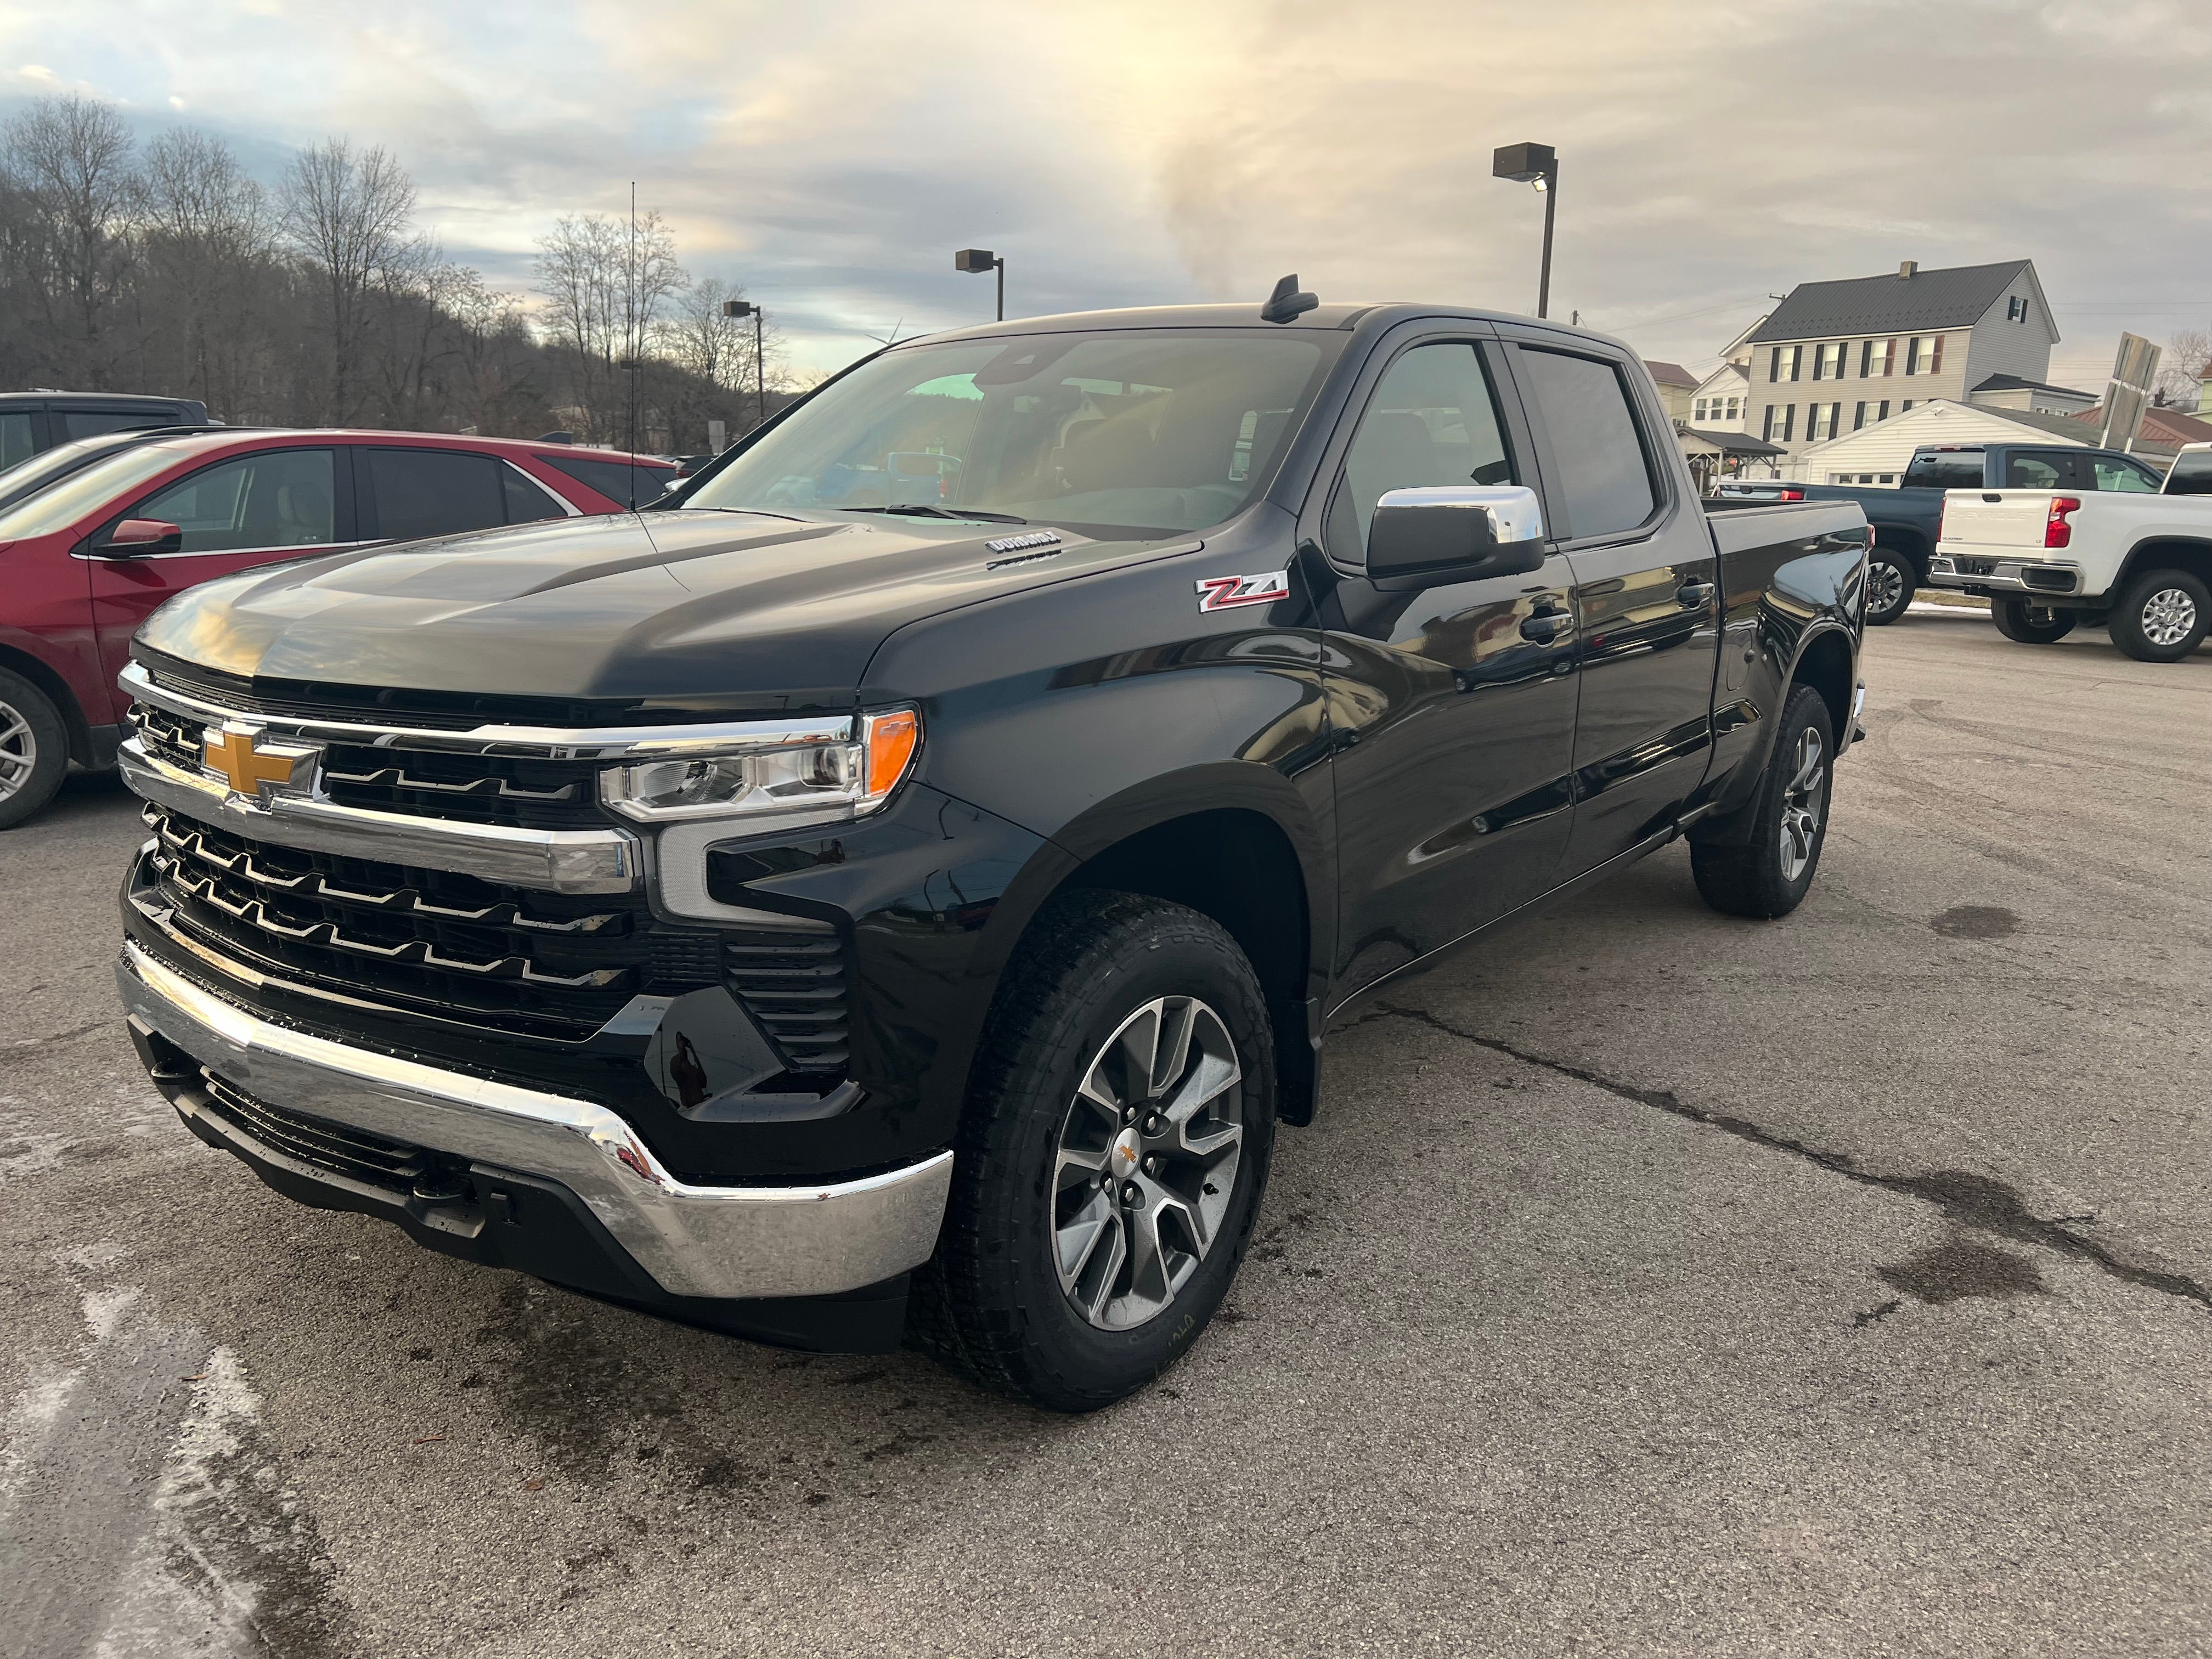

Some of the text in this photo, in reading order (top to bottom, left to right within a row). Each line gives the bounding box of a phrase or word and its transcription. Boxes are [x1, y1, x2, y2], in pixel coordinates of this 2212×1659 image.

[1948, 510, 2039, 521] CHEVROLET
[985, 531, 1062, 554] DURAMAX
[1194, 569, 1289, 613] Z71
